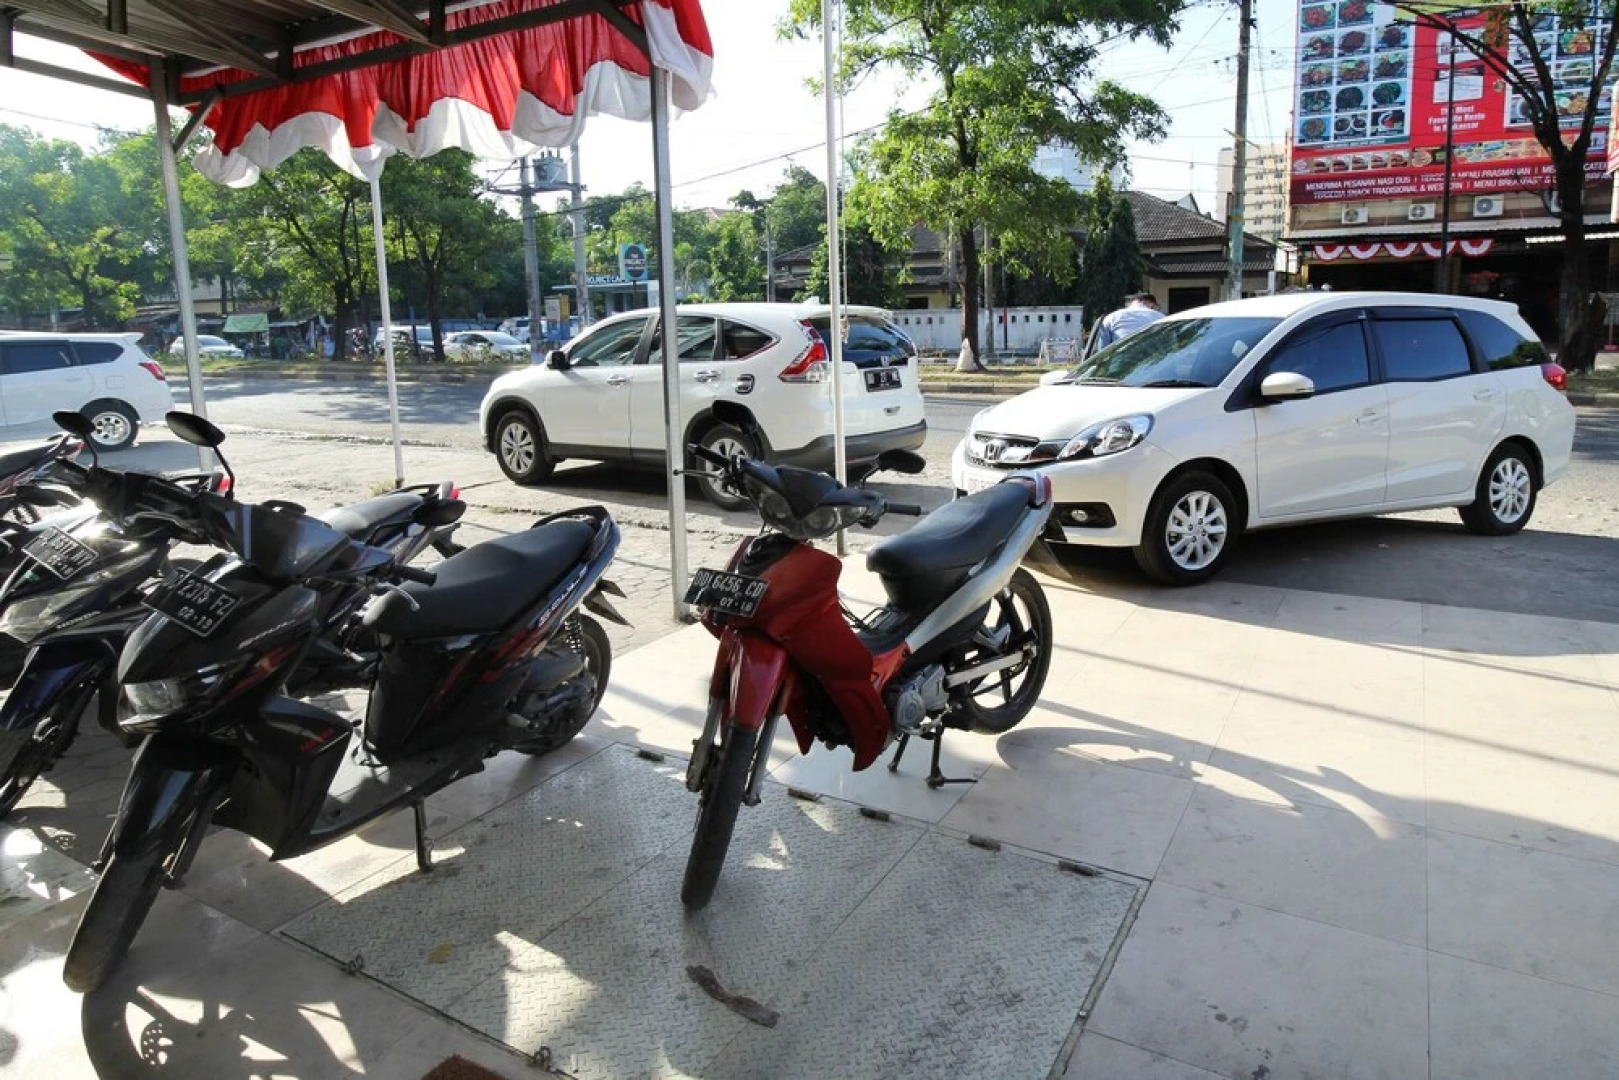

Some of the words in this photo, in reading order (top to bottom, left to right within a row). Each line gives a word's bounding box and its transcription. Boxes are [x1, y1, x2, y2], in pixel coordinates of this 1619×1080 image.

[1455, 105, 1474, 113] Most
[1442, 122, 1479, 131] Mkassar
[1305, 180, 1342, 190] MENERIMA
[1343, 178, 1376, 188] PESANAN
[1377, 177, 1394, 186] NASI
[1395, 176, 1411, 184] DUS
[1372, 185, 1418, 195] TRADISIONAL
[1428, 182, 1463, 192] WESERN
[1473, 180, 1497, 189] MENU
[711, 575, 743, 593] 6456
[209, 593, 236, 616] FZ
